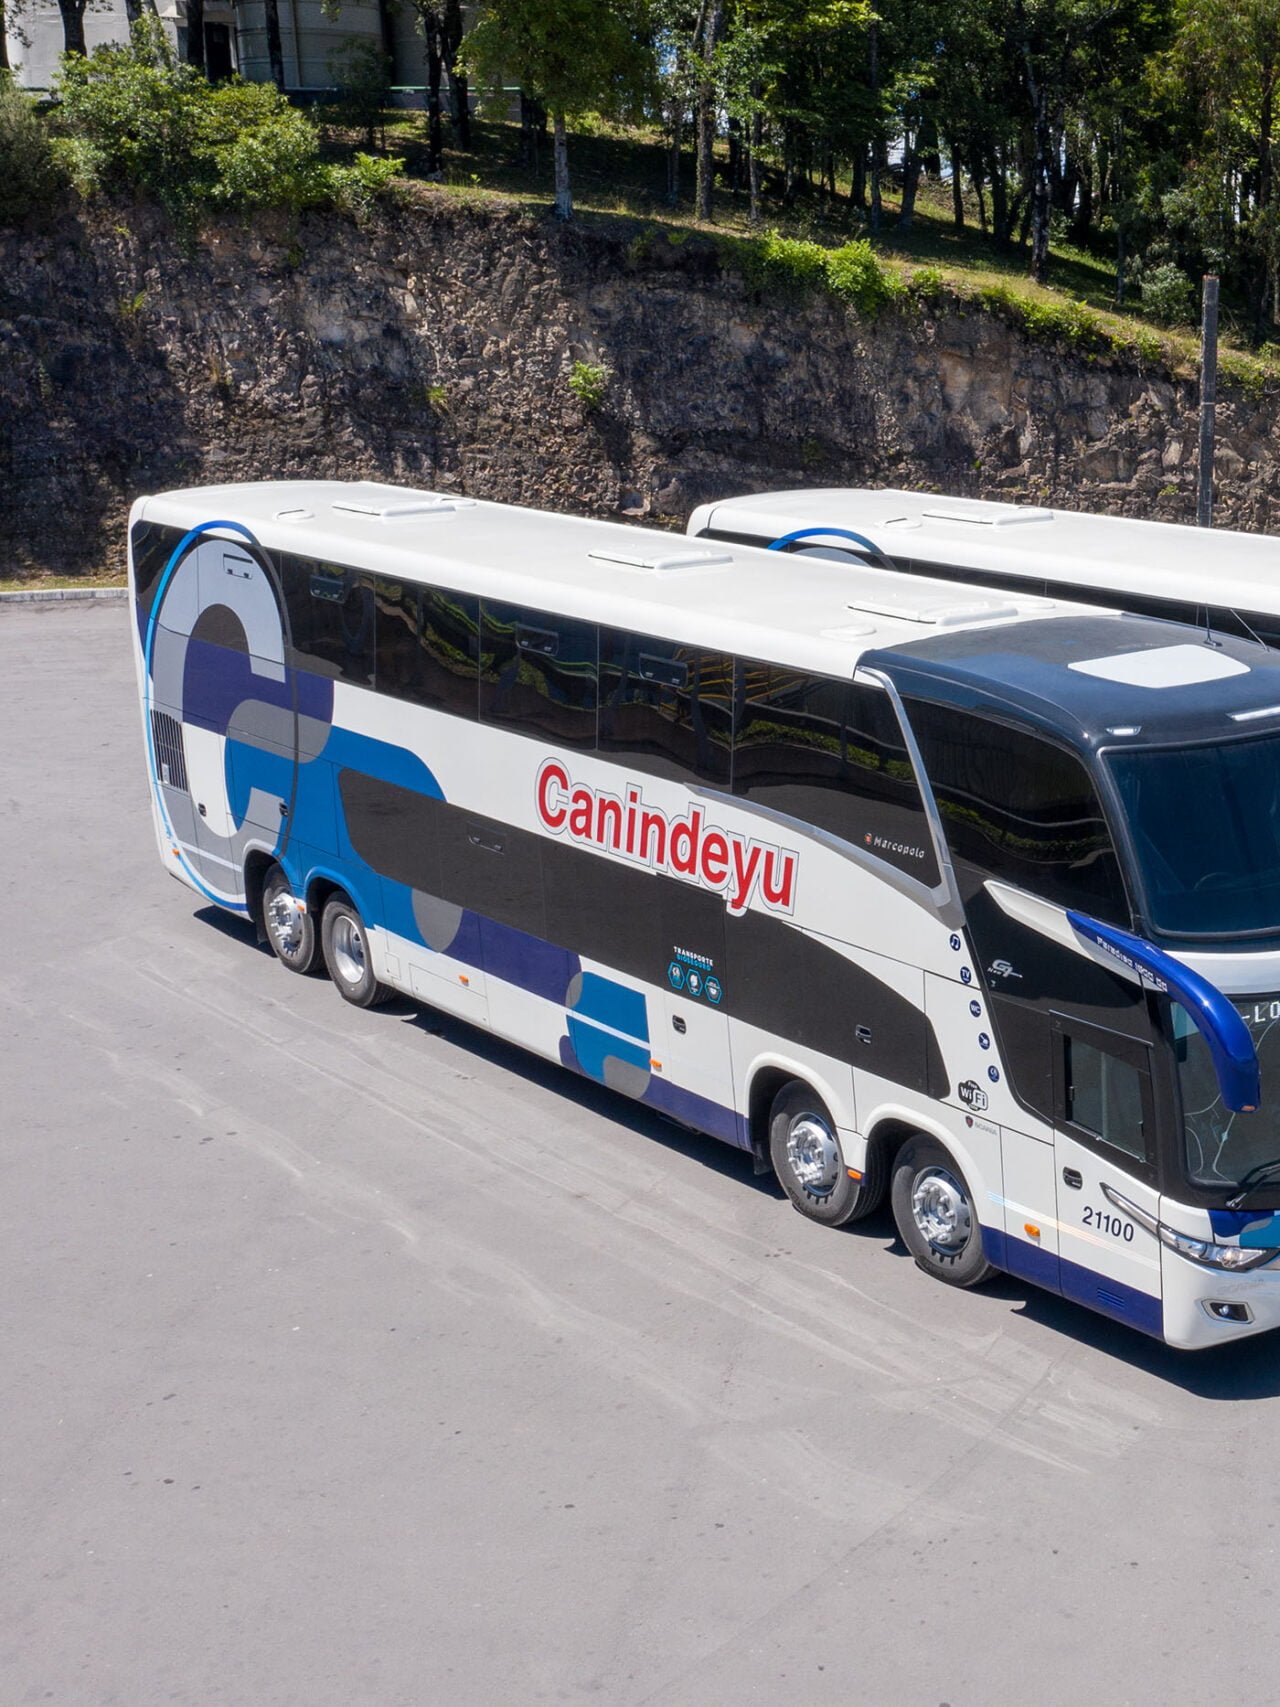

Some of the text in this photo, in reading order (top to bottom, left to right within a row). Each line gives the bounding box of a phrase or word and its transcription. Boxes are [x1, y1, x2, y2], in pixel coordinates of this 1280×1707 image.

[538, 763, 794, 910] Canindeyu
[873, 836, 925, 859] Marcopolo
[673, 945, 714, 967] TRANSPORTE
[961, 968, 971, 979] TV
[970, 1003, 981, 1013] WC
[1081, 1205, 1135, 1242] 21100
